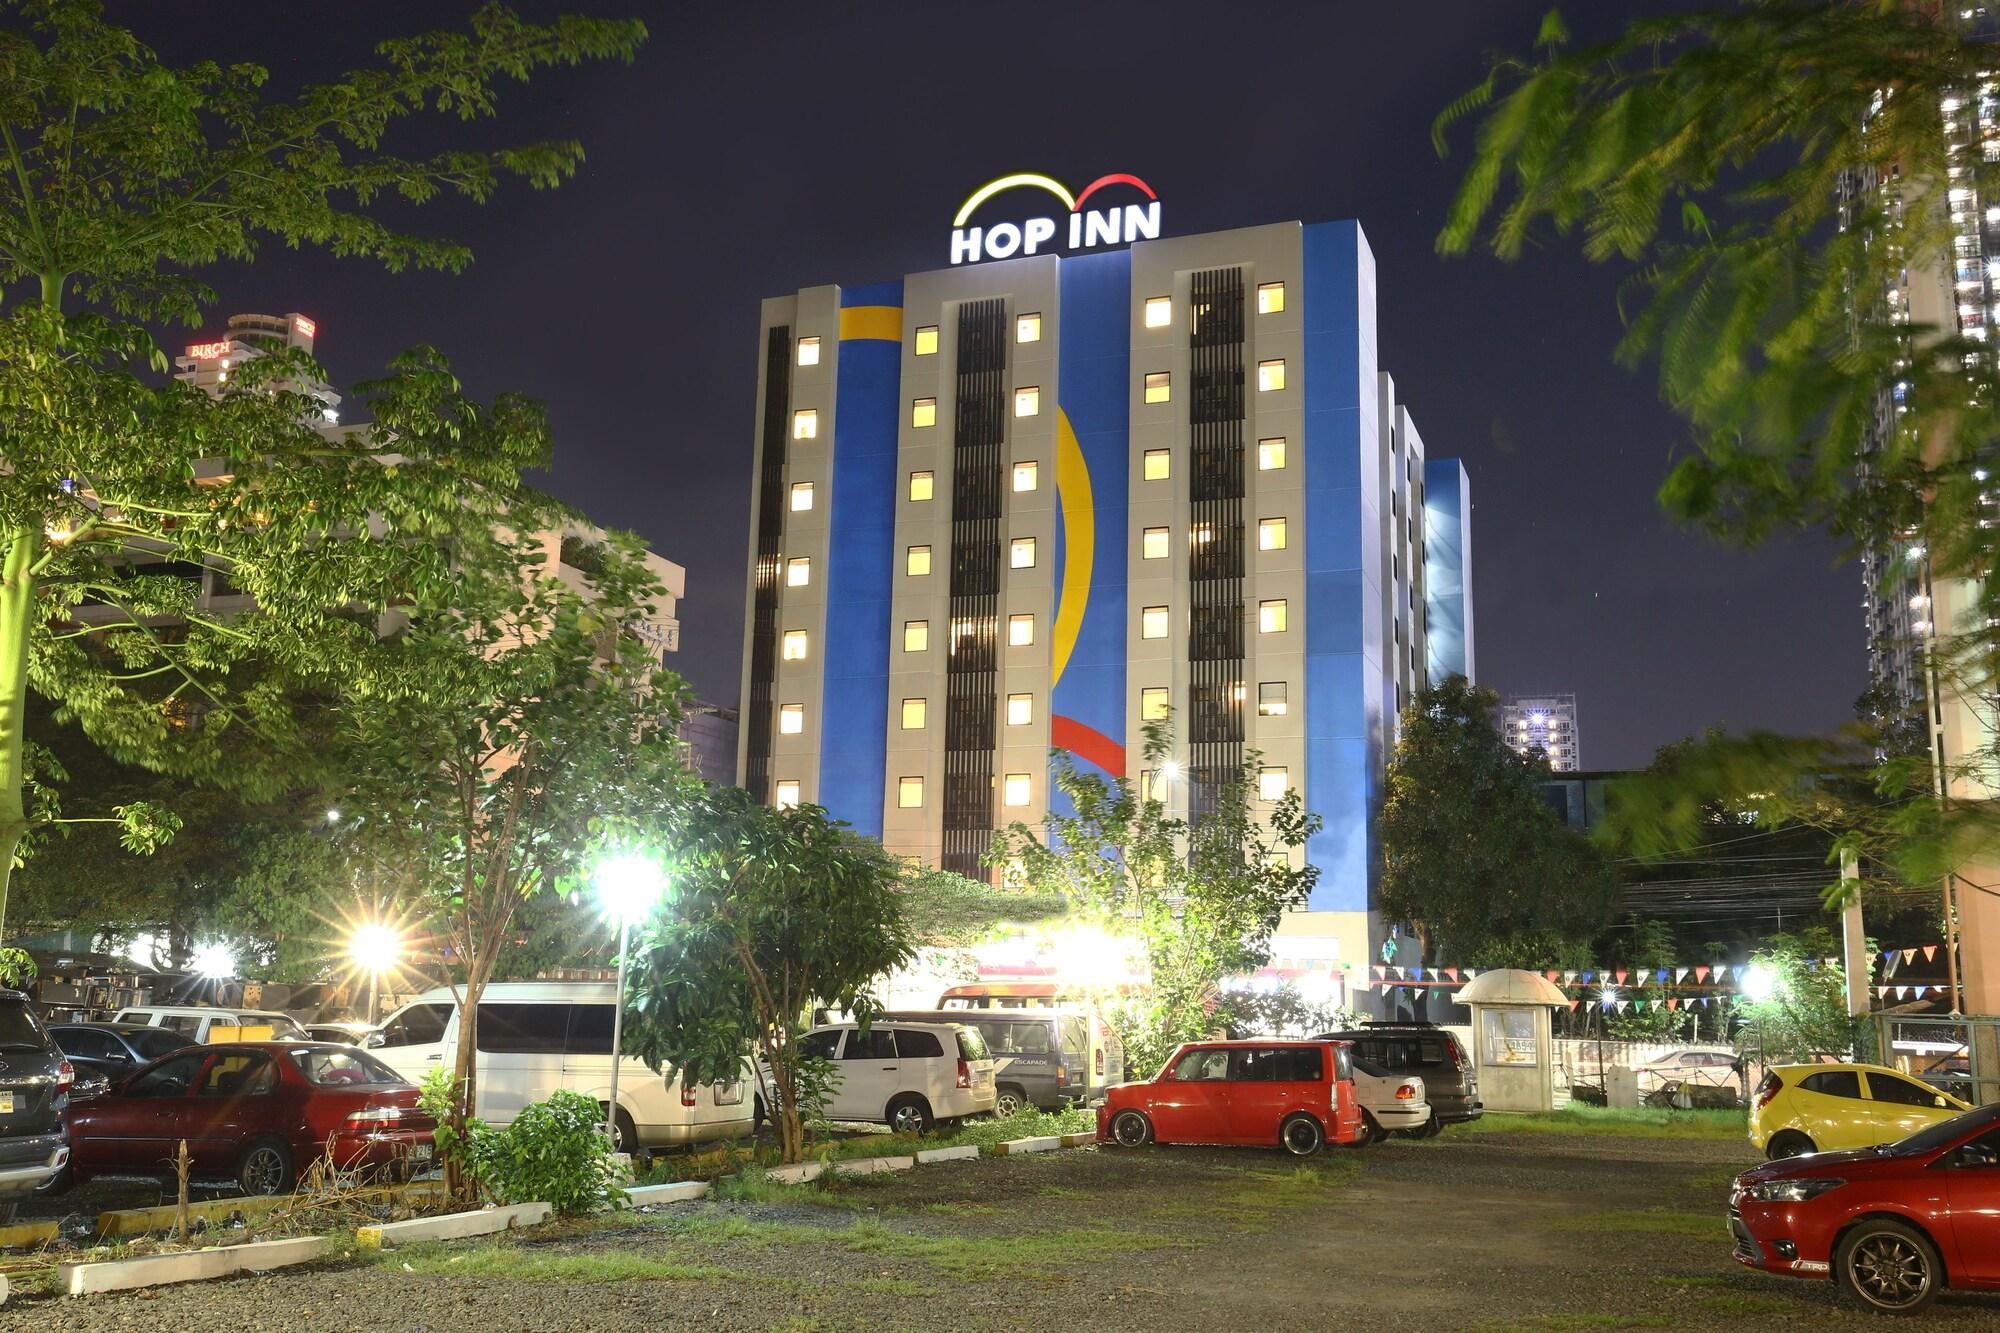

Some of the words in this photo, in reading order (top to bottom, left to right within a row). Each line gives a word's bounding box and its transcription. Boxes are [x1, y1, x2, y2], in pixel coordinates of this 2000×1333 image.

[950, 217, 1056, 265] HOP
[1068, 201, 1161, 249] INN
[191, 341, 231, 357] BIRCH
[1806, 1262, 1828, 1271] TRD
